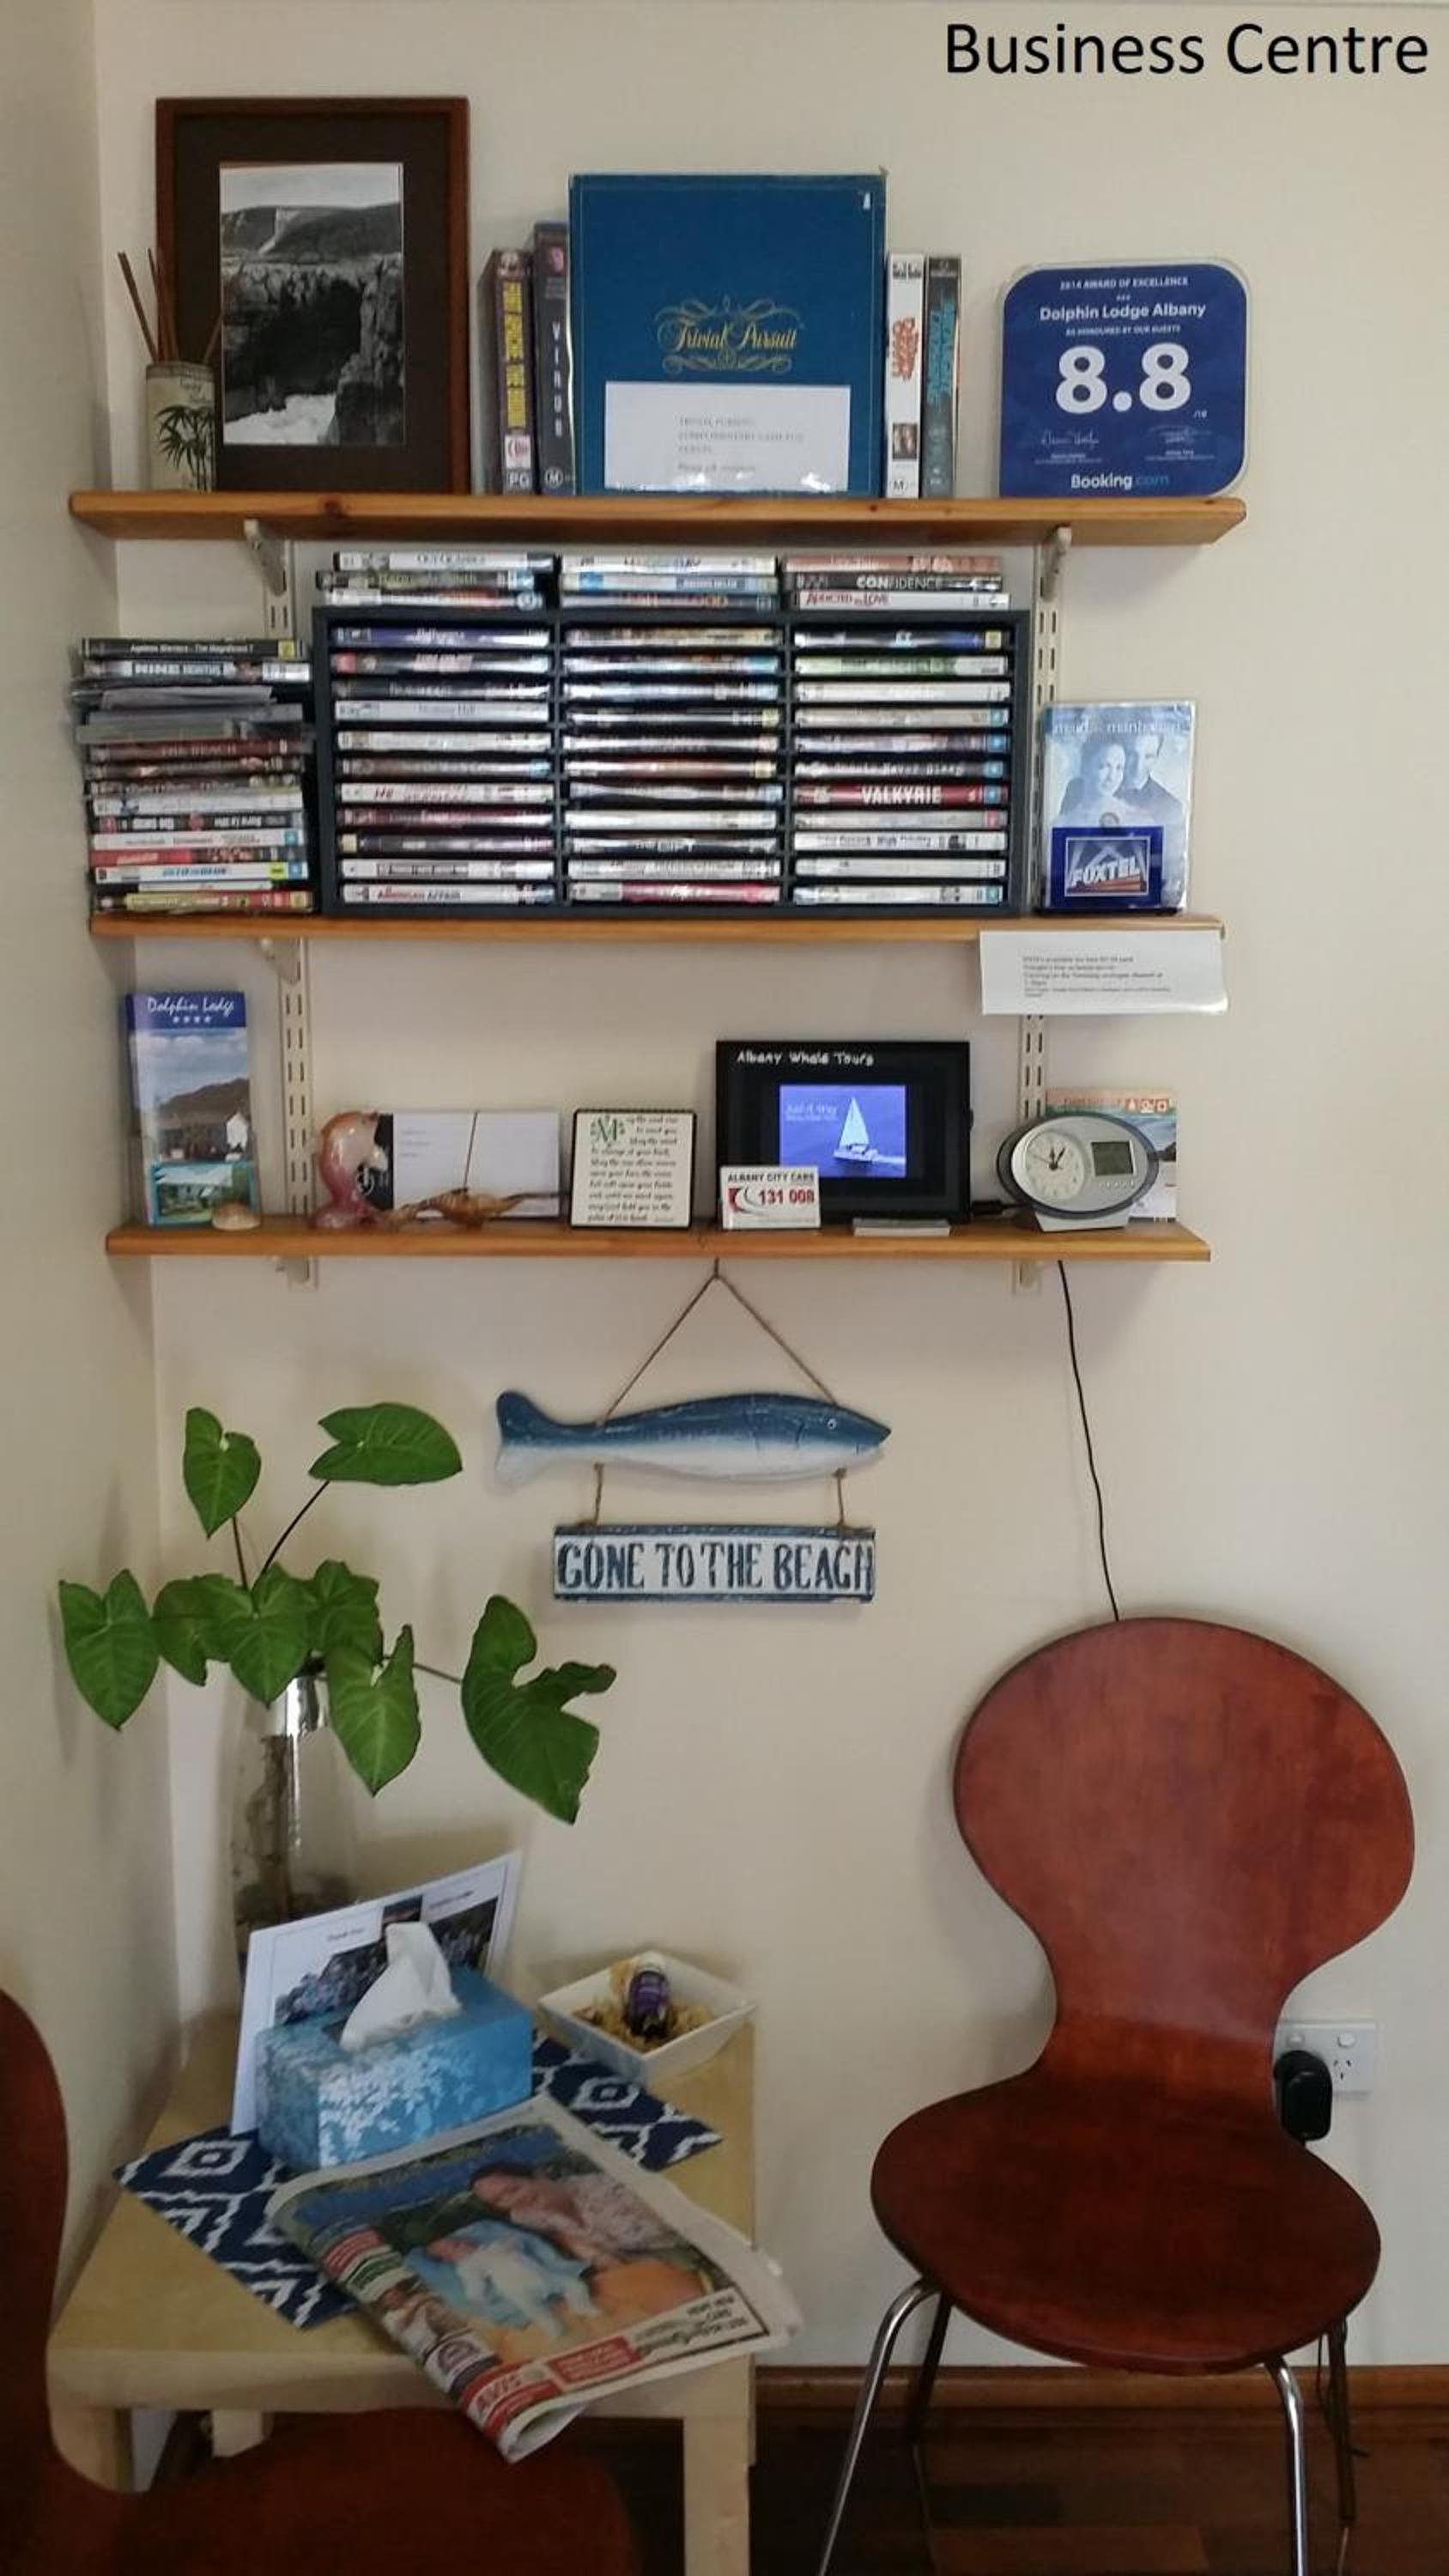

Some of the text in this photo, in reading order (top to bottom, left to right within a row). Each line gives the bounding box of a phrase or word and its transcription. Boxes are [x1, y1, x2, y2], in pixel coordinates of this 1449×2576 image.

[1083, 279, 1116, 289] AWARD
[1119, 277, 1130, 288] OF
[1132, 276, 1188, 287] EXCELLENCE
[1040, 302, 1206, 323] Dolphin Lodge Albany
[659, 318, 797, 352] Trivial Pursuit
[1056, 343, 1191, 414] 8.8
[861, 785, 942, 805] VALKYRIE
[1070, 856, 1142, 885] FOXTEL
[148, 996, 198, 1016] Dolphin
[737, 1049, 875, 1067] Albany Whale Tours
[728, 1173, 764, 1182] ALBANY
[767, 1173, 788, 1182] CITY
[758, 1188, 815, 1206] 131 008
[557, 1542, 873, 1591] GONE TO THE BEACH
